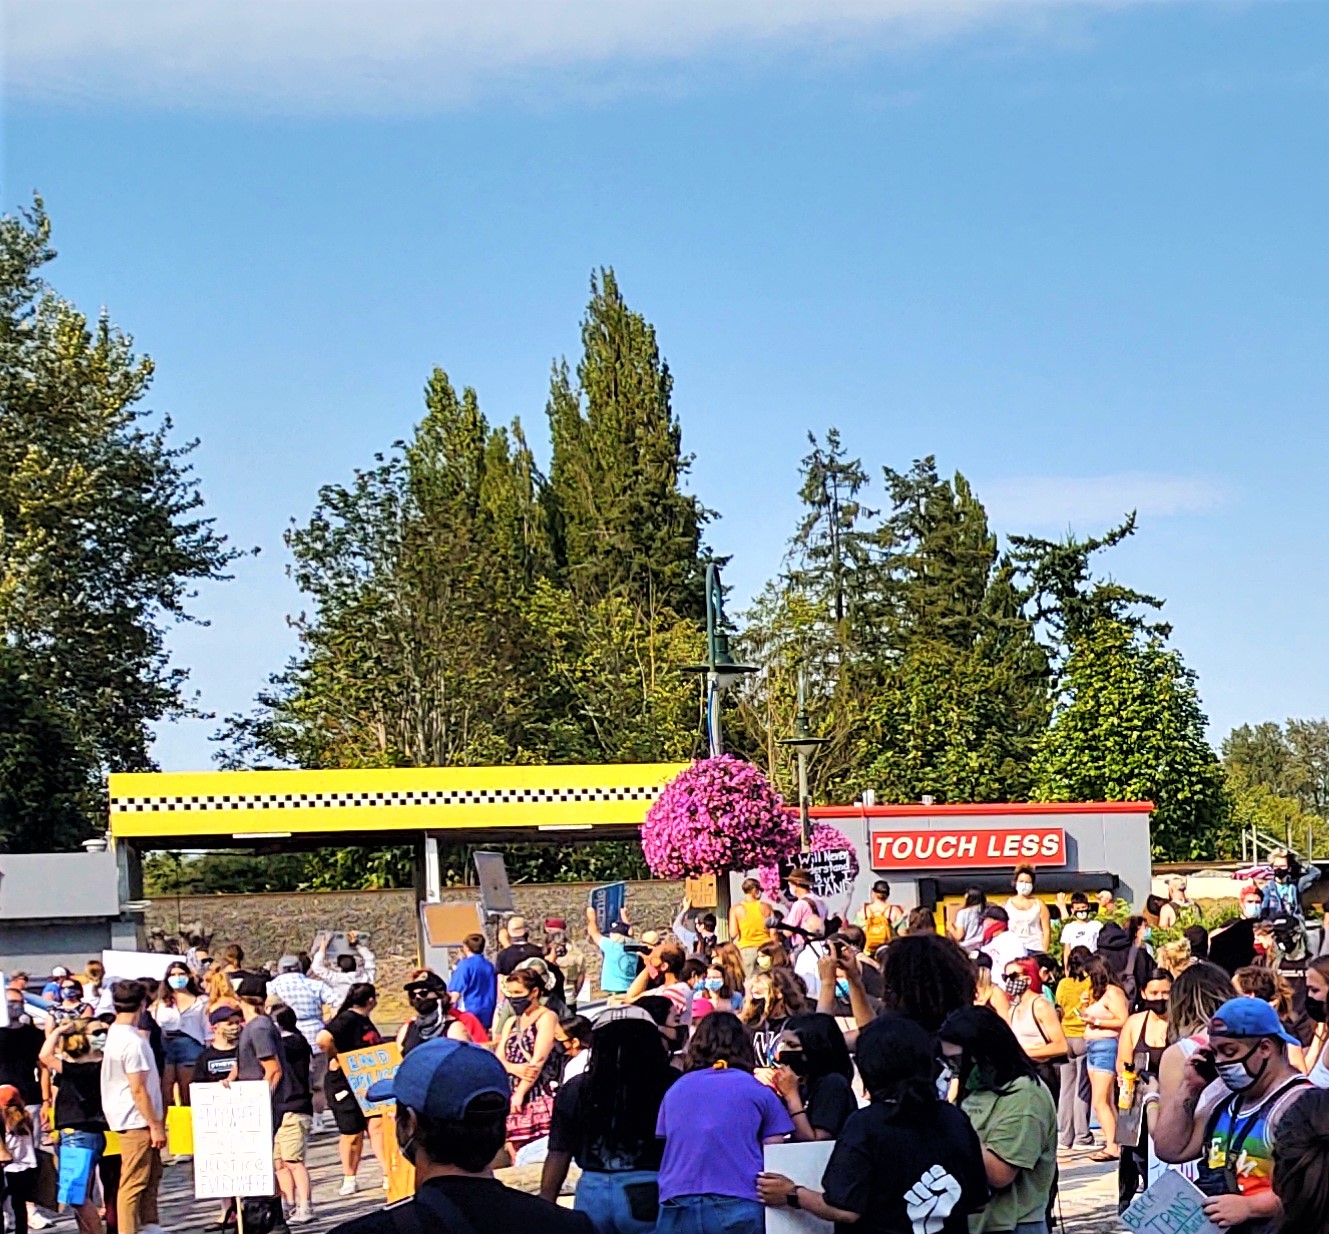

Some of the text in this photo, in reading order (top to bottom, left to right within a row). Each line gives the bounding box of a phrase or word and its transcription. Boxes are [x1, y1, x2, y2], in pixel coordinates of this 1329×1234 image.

[798, 852, 822, 864] Will
[876, 834, 1060, 859] TOUCH LESS
[842, 870, 852, 880] I
[346, 1049, 390, 1072] END
[1122, 1191, 1160, 1230] BLACK
